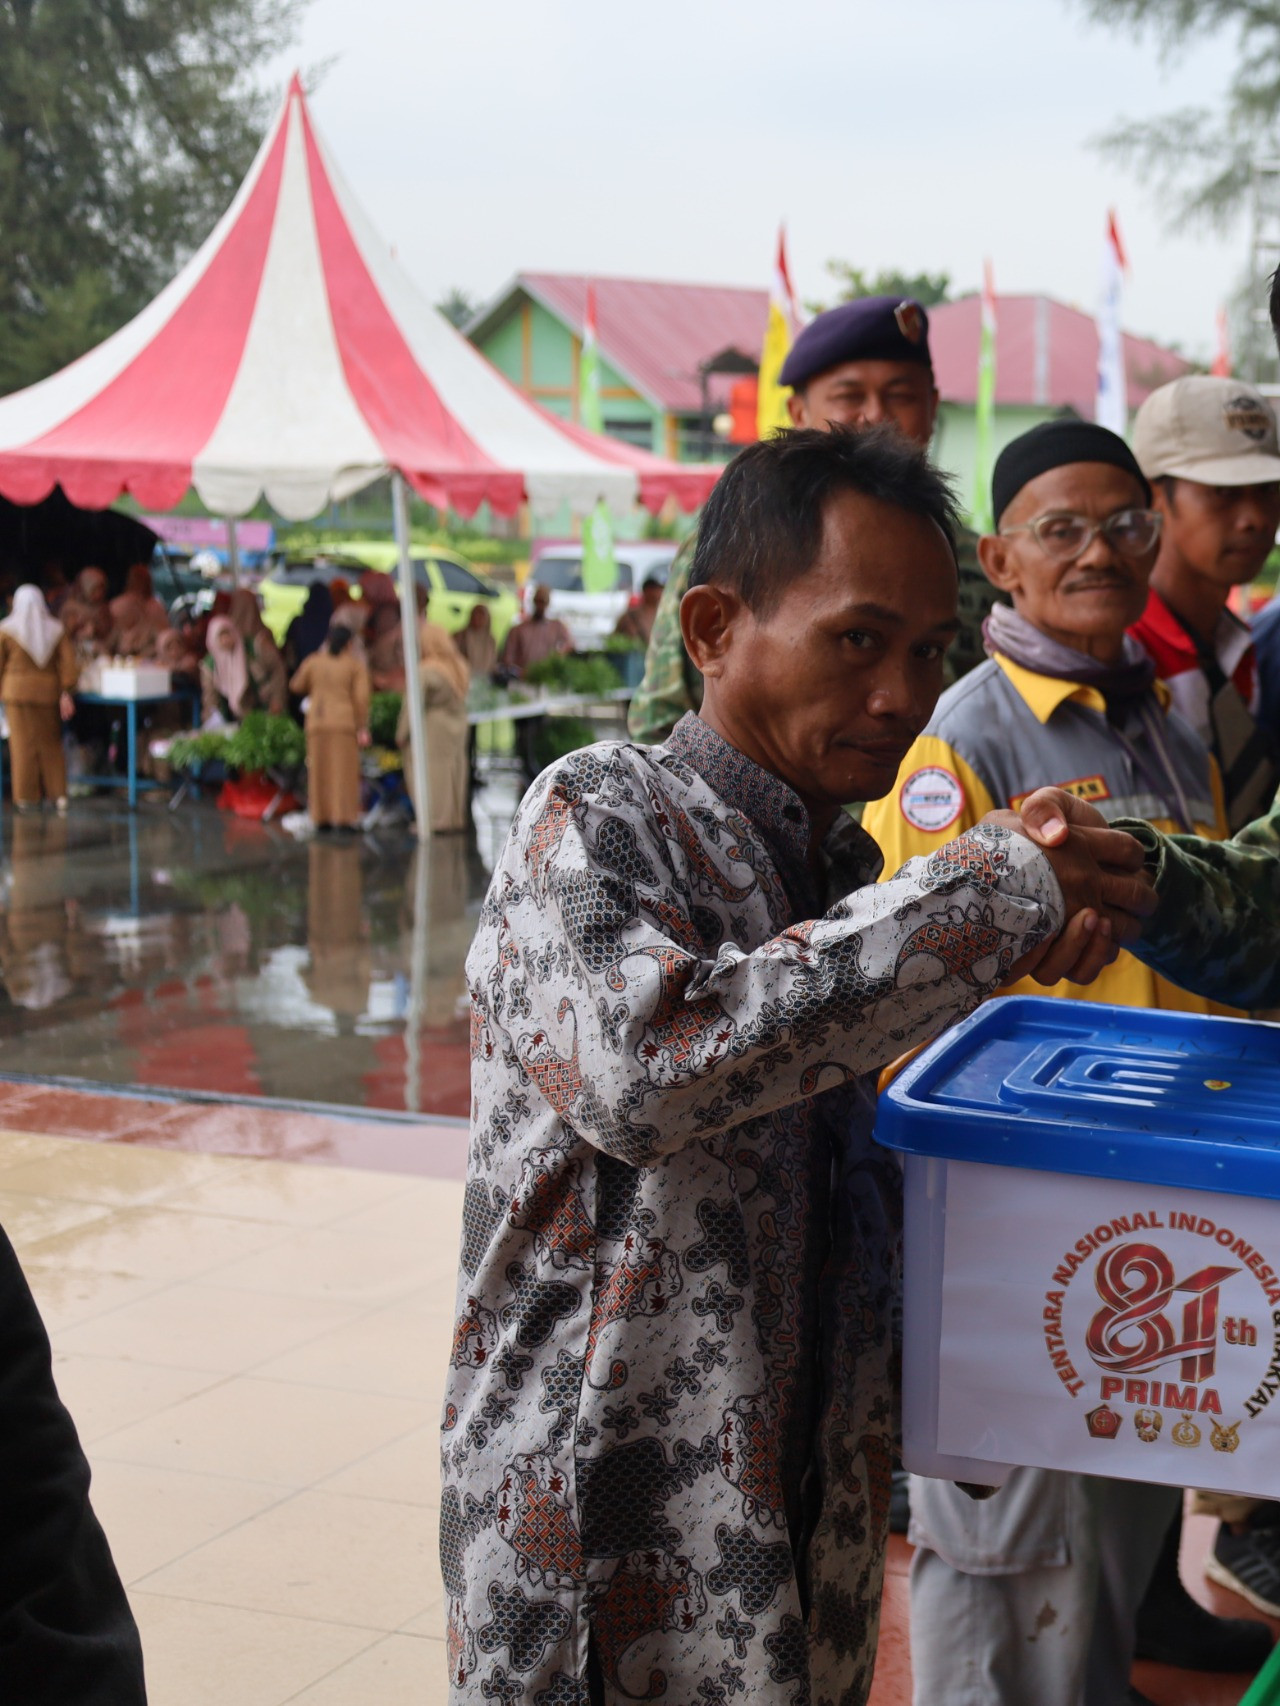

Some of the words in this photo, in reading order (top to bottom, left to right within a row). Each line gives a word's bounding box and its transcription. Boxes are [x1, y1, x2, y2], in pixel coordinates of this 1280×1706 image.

[1052, 1211, 1163, 1286] NASIONAL
[1043, 1290, 1087, 1398] TENTARA
[1100, 1376, 1223, 1415] PRIMA
